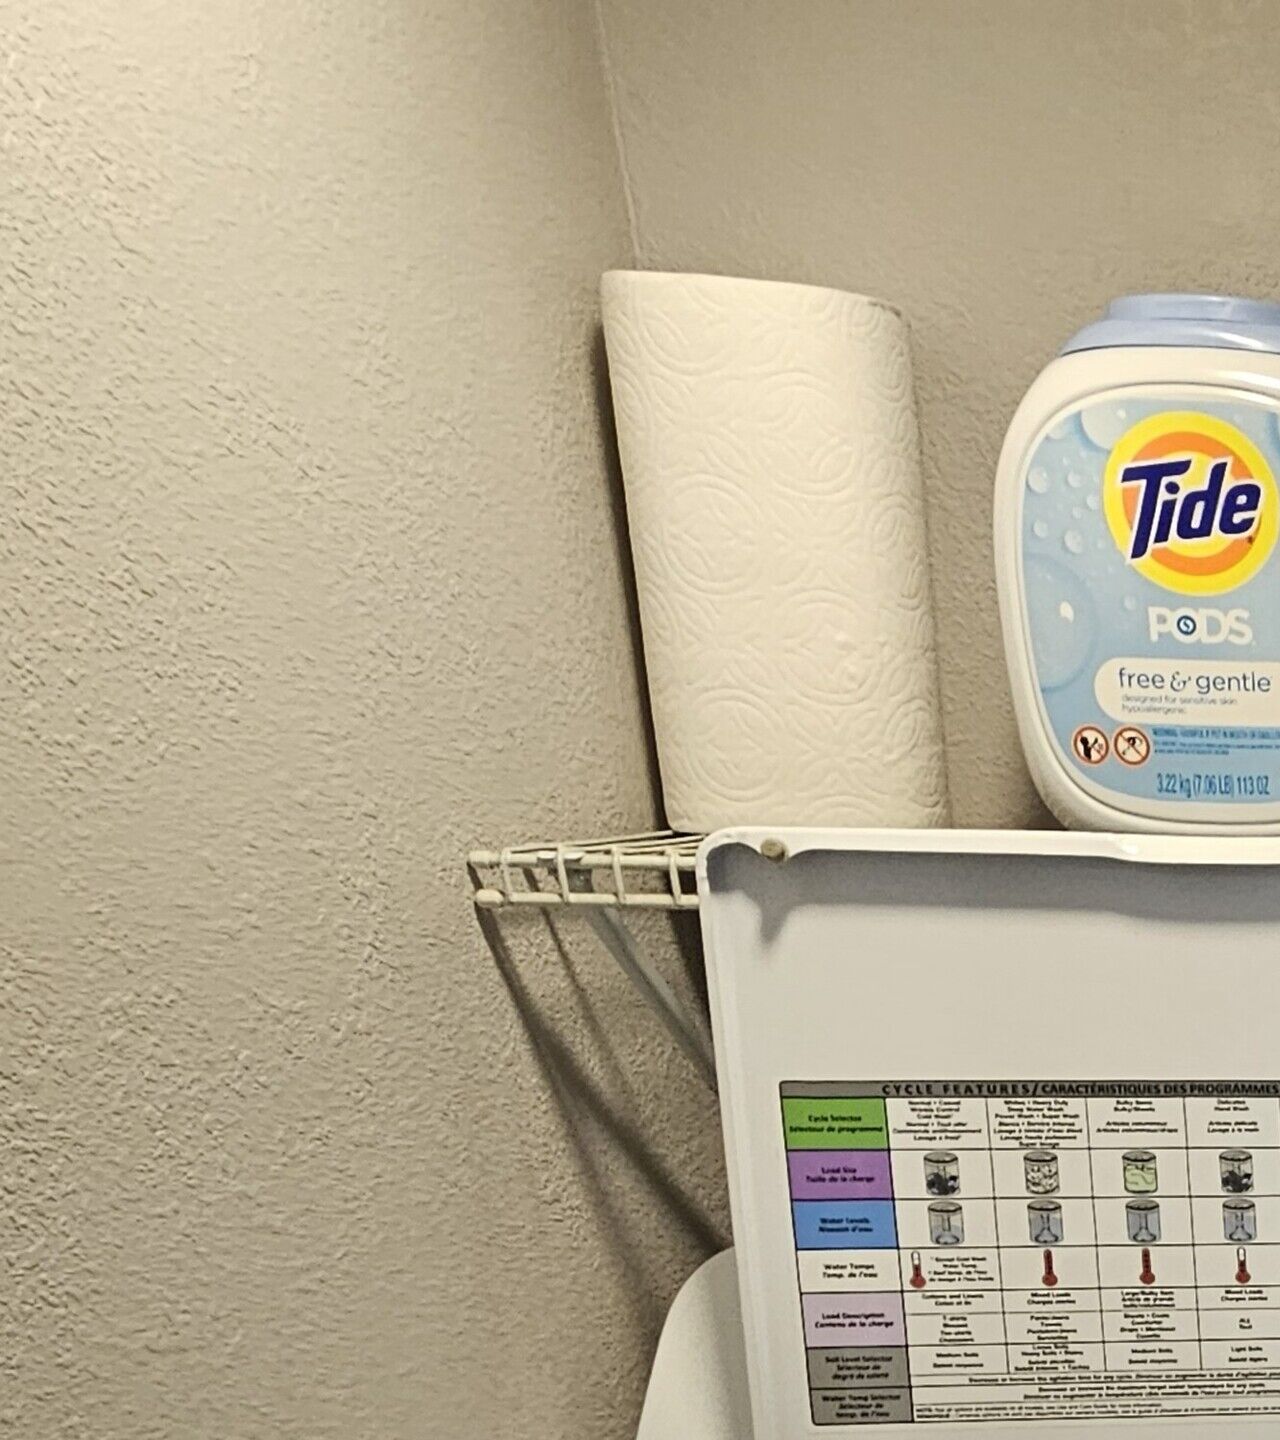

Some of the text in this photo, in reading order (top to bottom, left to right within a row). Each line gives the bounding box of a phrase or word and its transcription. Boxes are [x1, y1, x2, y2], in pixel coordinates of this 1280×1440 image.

[1121, 459, 1261, 559] Tide
[1148, 606, 1253, 646] PODS
[1119, 667, 1272, 695] free & gentle
[1157, 774, 1177, 794] 3.22
[1179, 774, 1192, 798] kg
[1237, 776, 1254, 796] 113
[1257, 776, 1270, 796] OZ
[882, 1083, 934, 1096] CYCLE
[1164, 1082, 1188, 1095] DES
[1190, 1082, 1279, 1095] PROGRAMMES
